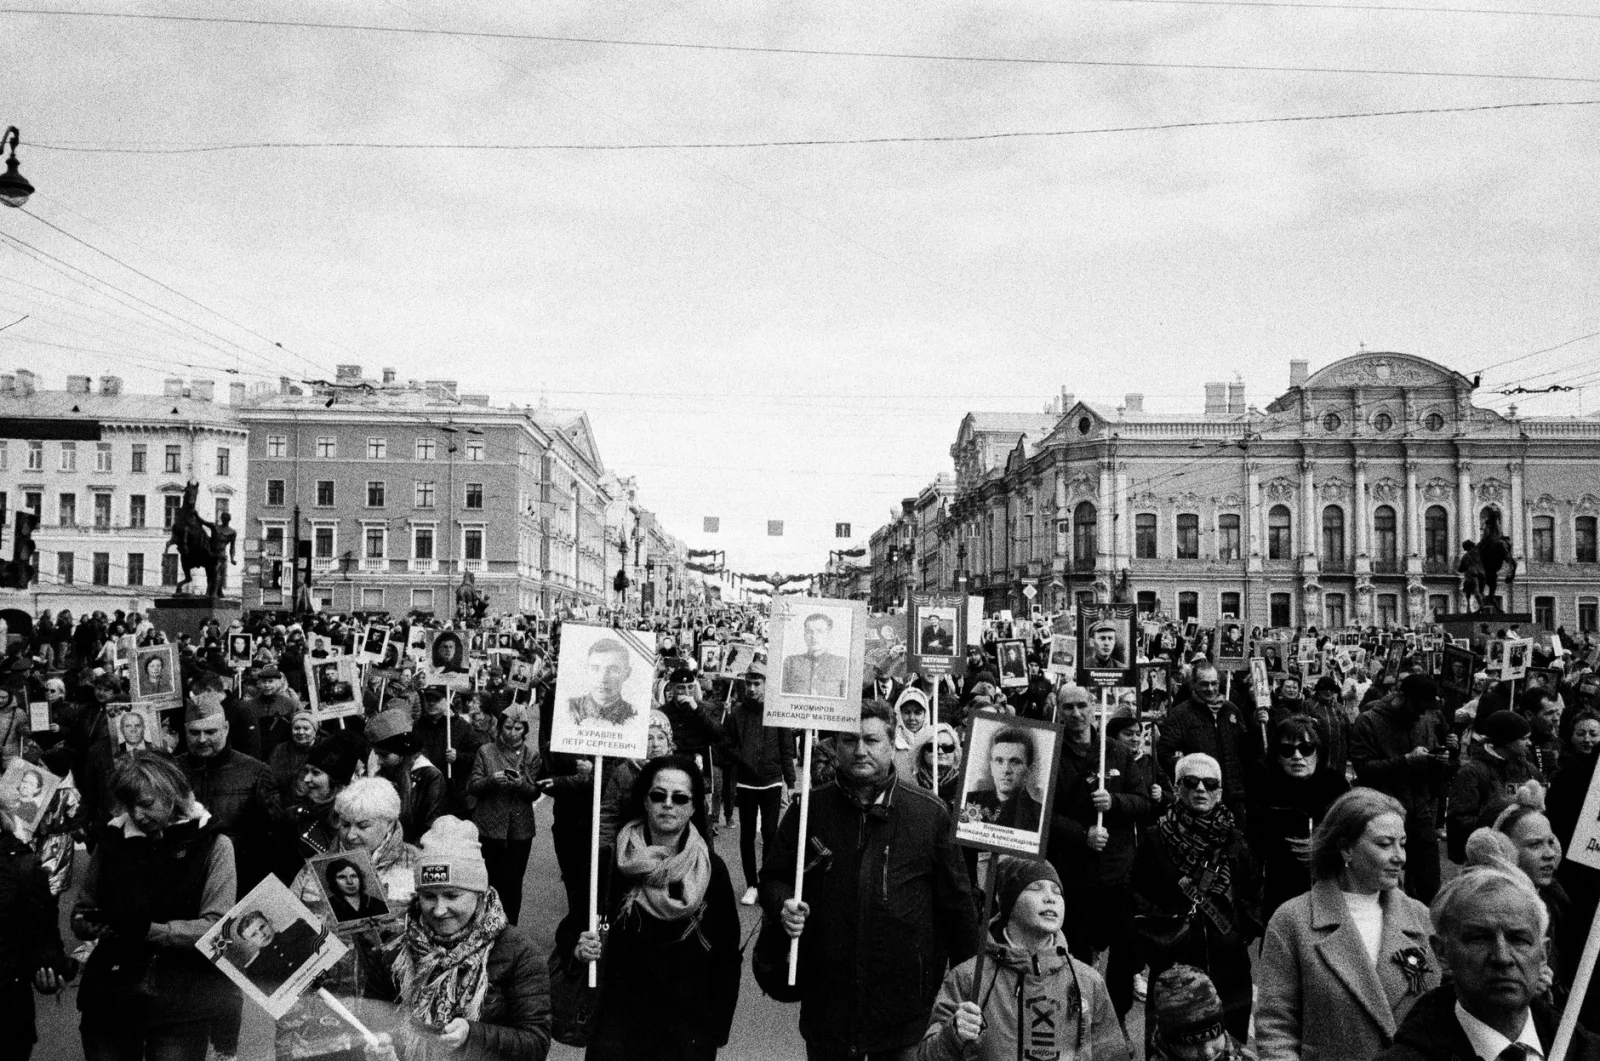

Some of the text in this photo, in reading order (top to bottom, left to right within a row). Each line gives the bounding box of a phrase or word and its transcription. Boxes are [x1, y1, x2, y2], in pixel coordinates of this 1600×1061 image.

[790, 703, 835, 713] ТИХОМИРОВ
[766, 710, 857, 723] АЛЕКСАНДР МАТВЕЕВИЧ
[577, 729, 623, 740] ЖУРАВЛЕВ
[562, 738, 636, 750] ПЕТР СЕРГЕЕВИЧ
